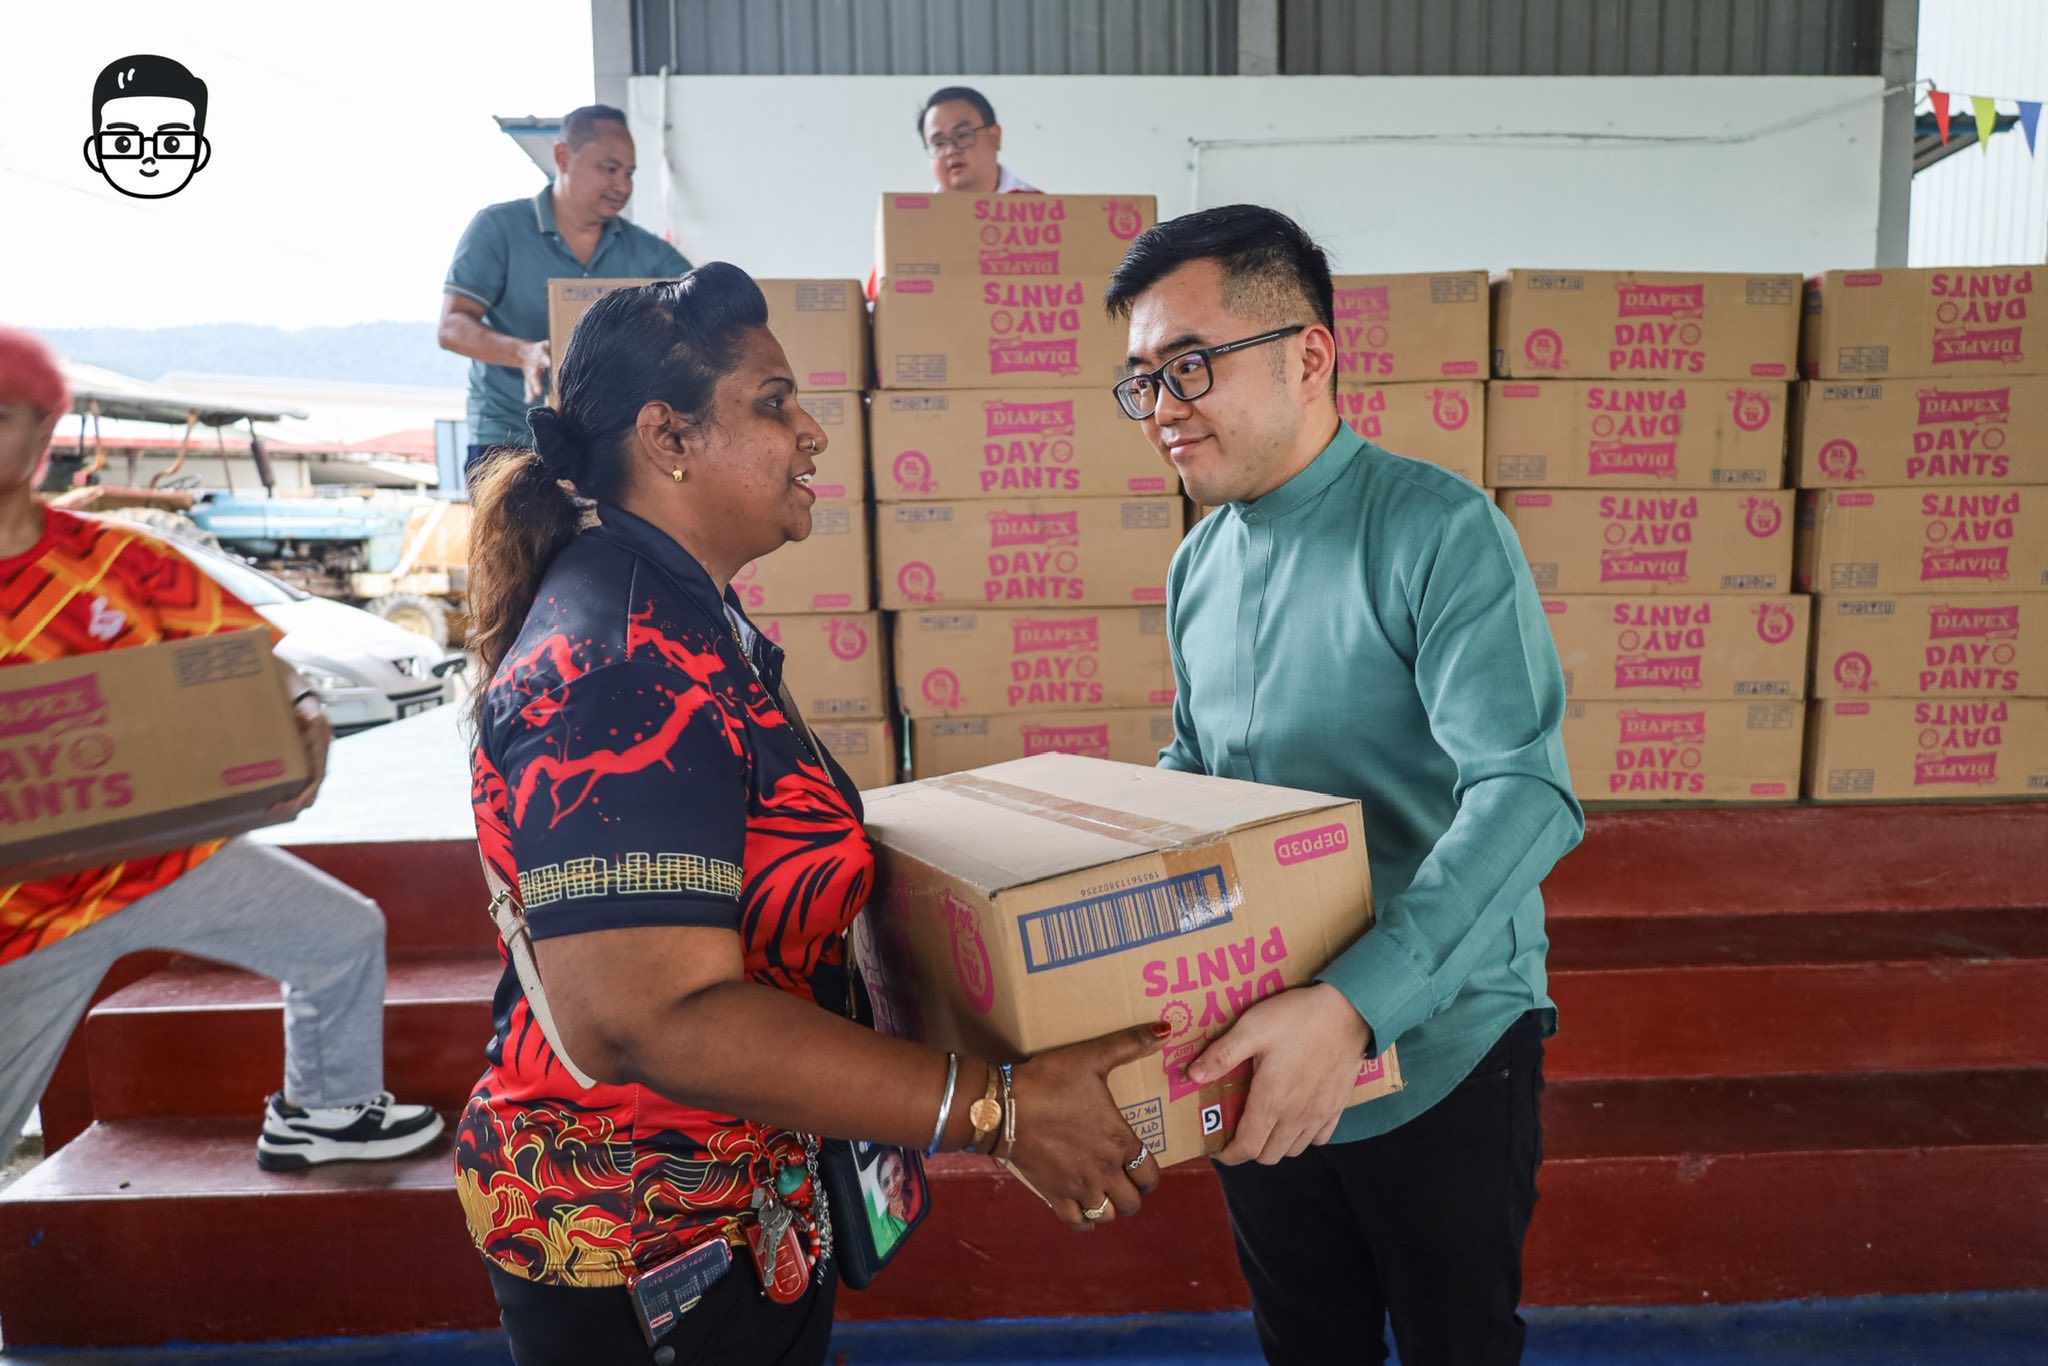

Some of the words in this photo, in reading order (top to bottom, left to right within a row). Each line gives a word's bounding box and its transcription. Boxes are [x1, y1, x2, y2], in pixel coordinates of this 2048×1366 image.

[975, 199, 1066, 223] PANTS
[1003, 224, 1061, 248] DAY
[988, 260, 1053, 274] DIAPEX
[984, 282, 1084, 308] PANTS
[1932, 272, 2032, 297] PANTS
[1625, 291, 1696, 307] DIAPEX
[1964, 296, 2027, 322] DAY
[1018, 308, 1080, 334] DAY
[1616, 322, 1676, 347] DAY
[1941, 338, 2014, 355] DIAPEX
[999, 350, 1071, 365] DIAPEX
[1610, 347, 1704, 373] PANTS
[1588, 387, 1686, 413] PANTS
[1925, 398, 2000, 414] DIAPEX
[992, 409, 1066, 426] DIAPEX
[1618, 413, 1680, 437] DAY
[984, 441, 1047, 465] DAY
[1913, 428, 1979, 454] DAY
[1599, 451, 1670, 467] DIAPEX
[1907, 452, 2009, 479] PANTS
[980, 465, 1080, 491] PANTS
[1600, 496, 1698, 523] PANTS
[1923, 492, 2020, 519] PANTS
[996, 519, 1070, 536] DIAPEX
[1630, 520, 1692, 544] DAY
[1952, 516, 2014, 541] DAY
[988, 551, 1051, 576] DAY
[1609, 558, 1681, 574] DIAPEX
[1930, 557, 2001, 571] DIAPEX
[985, 576, 1084, 602] PANTS
[1615, 602, 1711, 628] PANTS
[1936, 614, 2010, 629] DIAPEX
[1020, 627, 1091, 644] DIAPEX
[1644, 627, 1705, 651] DAY
[1926, 643, 1988, 667] DAY
[1012, 656, 1072, 681] DAY
[1624, 663, 1695, 679] DIAPEX
[1920, 667, 2018, 691] PANTS
[1008, 681, 1103, 705] PANTS
[1916, 701, 2008, 726] PANTS
[1626, 719, 1697, 734] DIAPEX
[1942, 725, 2002, 748] DAY
[1030, 732, 1101, 748] DIAPEX
[1616, 747, 1677, 772] DAY
[1923, 763, 1991, 777] DIAPEX
[1610, 769, 1703, 792] PANTS
[1278, 830, 1345, 858] DEP03D
[1143, 926, 1288, 997] PANTS
[1144, 1105, 1157, 1116] PK
[1204, 1109, 1221, 1132] G
[1140, 1121, 1159, 1135] QTY
